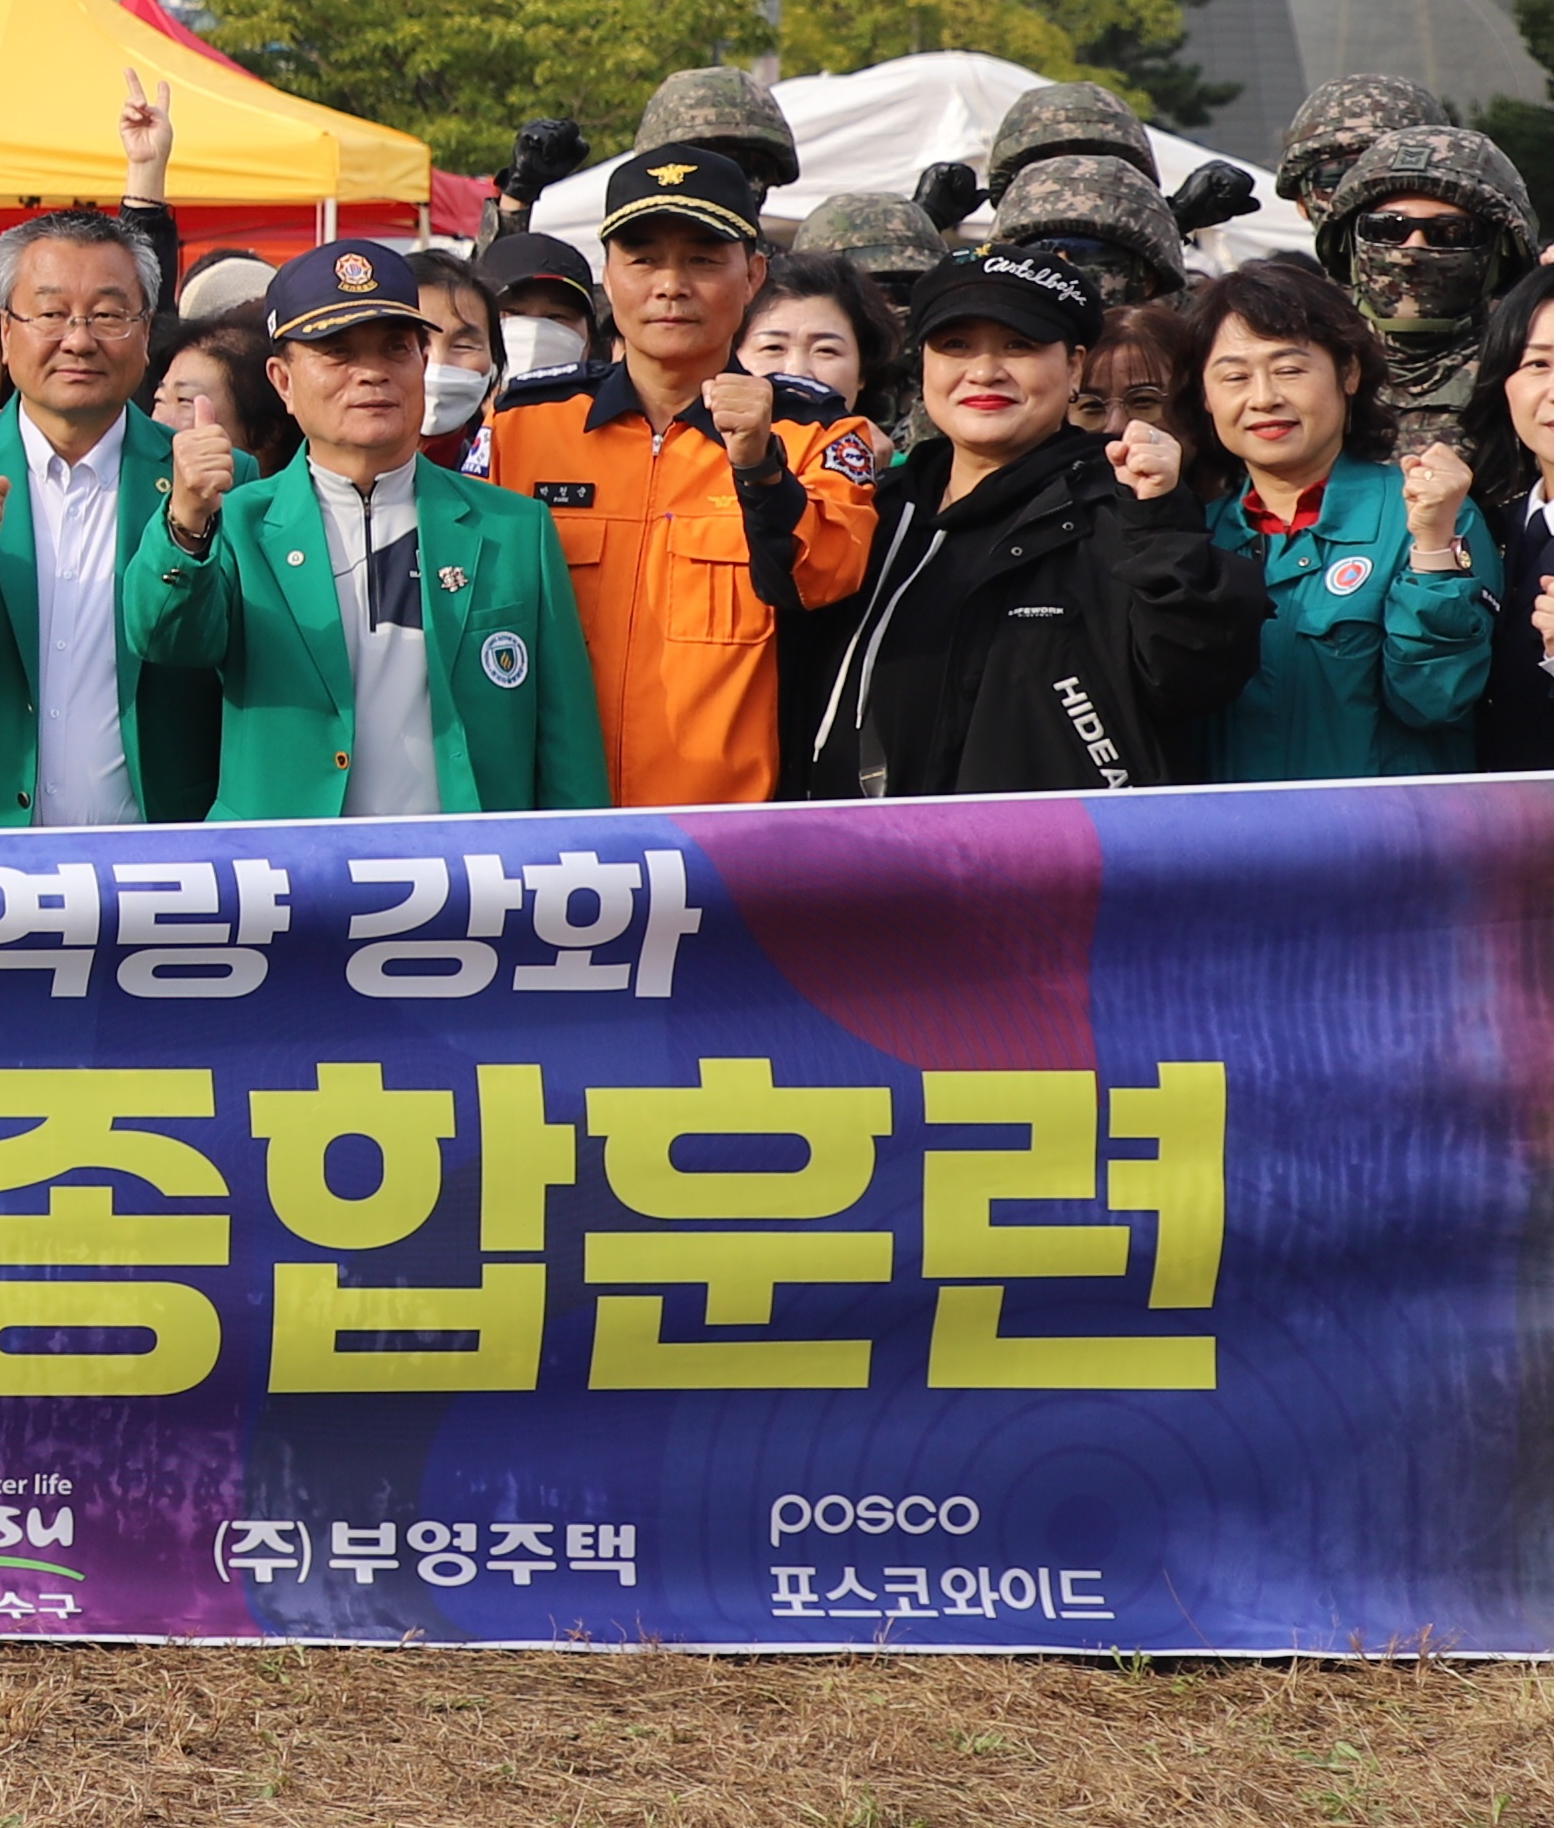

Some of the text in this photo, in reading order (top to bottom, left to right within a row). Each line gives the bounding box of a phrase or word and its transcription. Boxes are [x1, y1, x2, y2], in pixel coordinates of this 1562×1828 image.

[344, 849, 704, 1000] 강화
[33, 1473, 73, 1496] life
[770, 1493, 981, 1548] posco
[769, 1565, 1116, 1621] 포스코와이드
